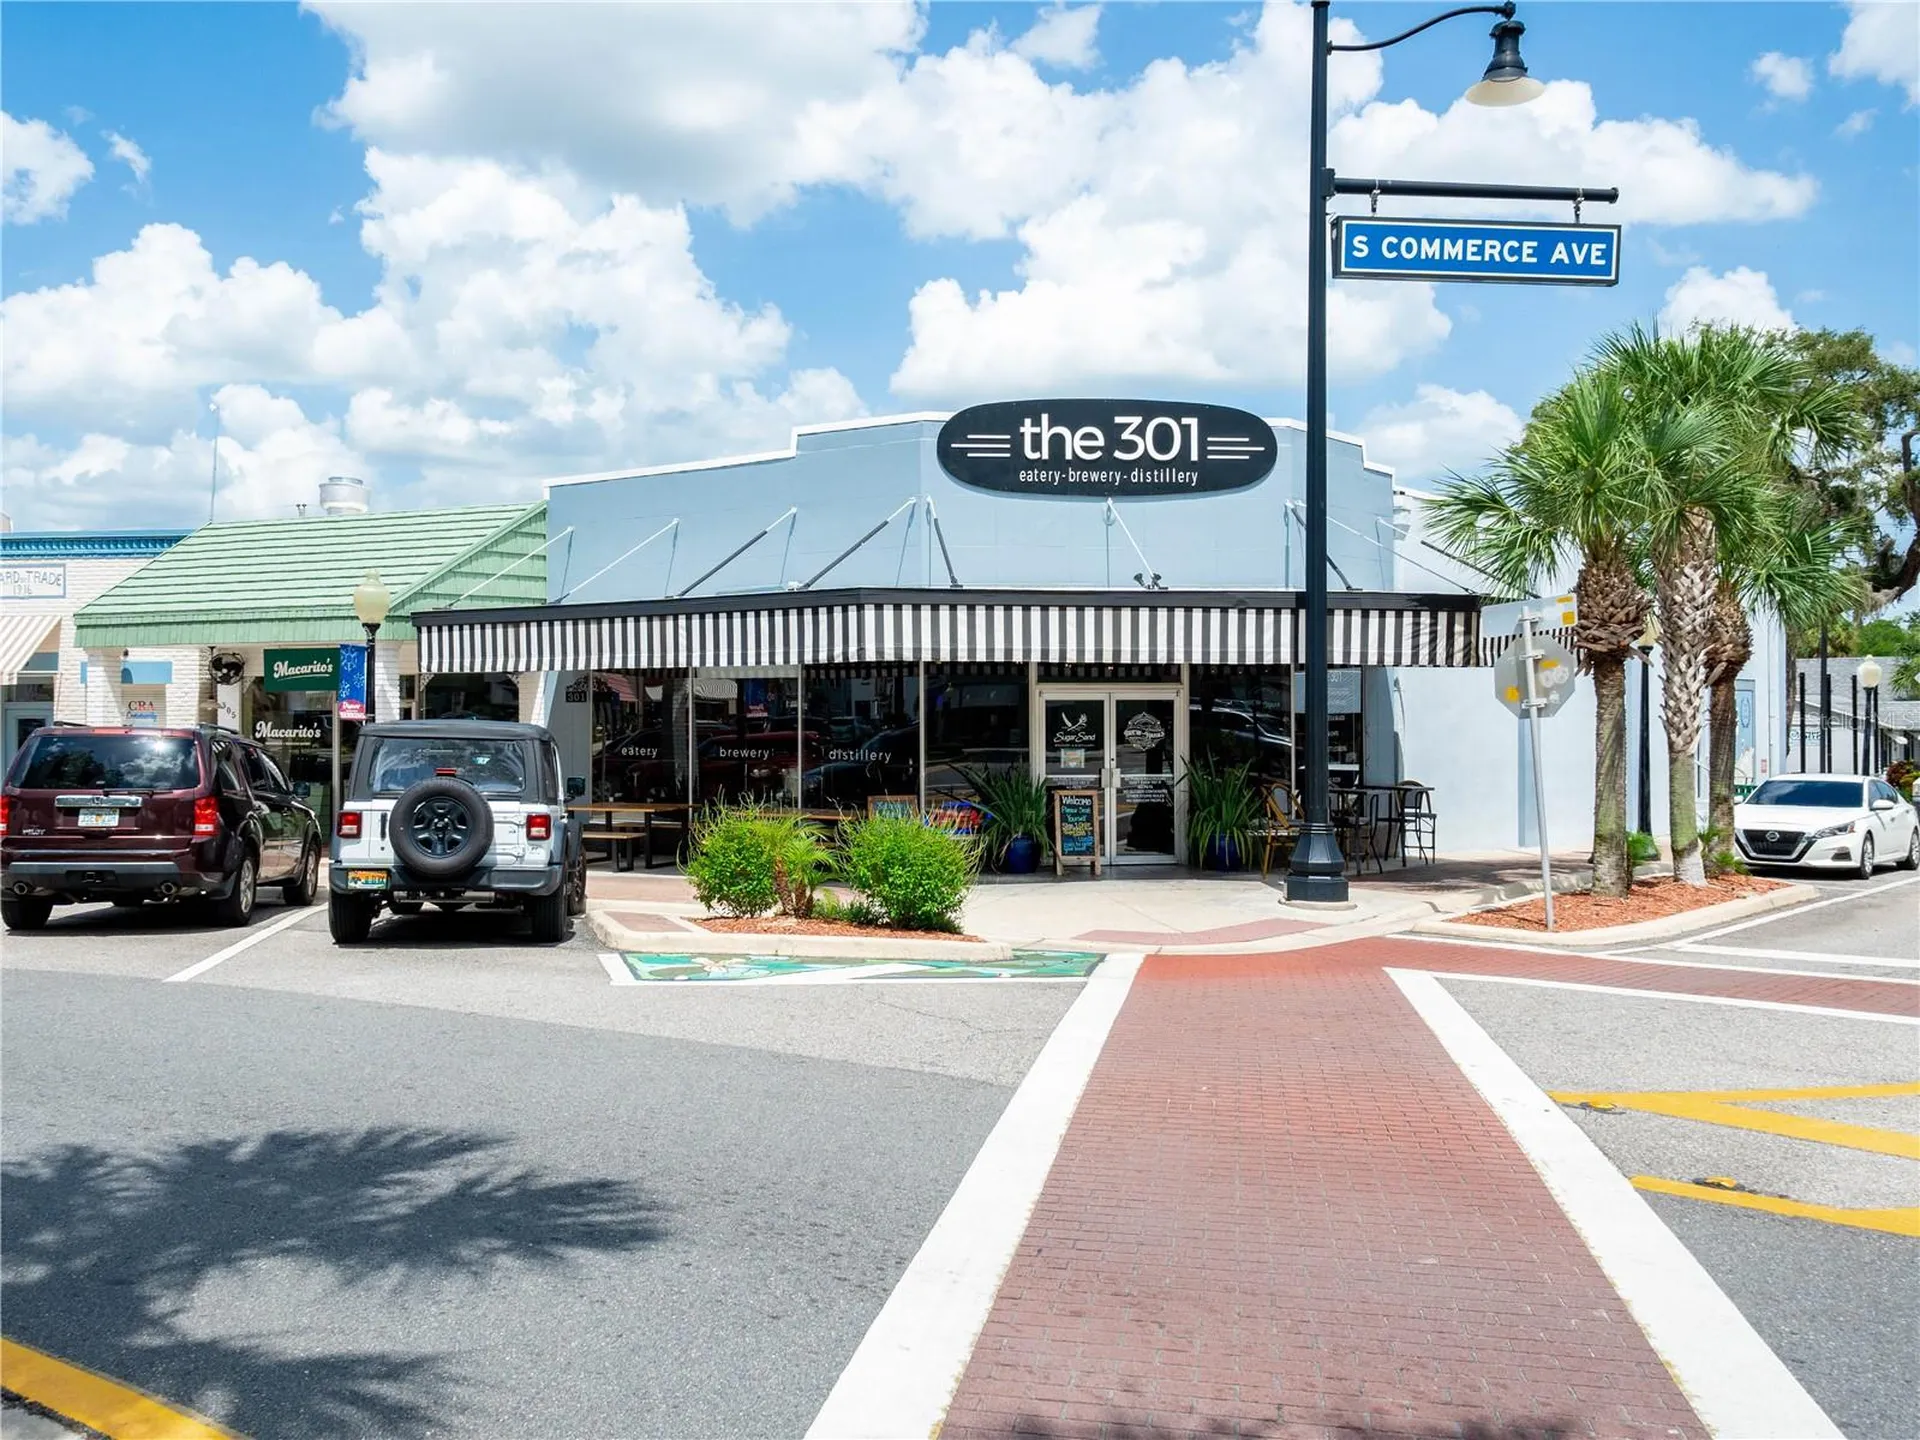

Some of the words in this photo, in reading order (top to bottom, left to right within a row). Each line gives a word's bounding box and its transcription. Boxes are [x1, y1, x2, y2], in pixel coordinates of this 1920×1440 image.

[1352, 235, 1369, 258] S
[1382, 236, 1538, 263] COMMERCE
[1550, 242, 1607, 265] AVE
[1019, 413, 1105, 461] the
[1113, 416, 1199, 461] 301
[25, 570, 62, 586] TRADE
[273, 658, 333, 678] Macarito's
[567, 692, 585, 702] 301
[128, 700, 154, 711] CRA
[255, 720, 321, 739] Macarito's
[1053, 732, 1077, 743] Sugar
[1075, 731, 1096, 743] Sand
[621, 746, 658, 758] eatery
[719, 746, 770, 761] brewery
[828, 748, 892, 764] distillery
